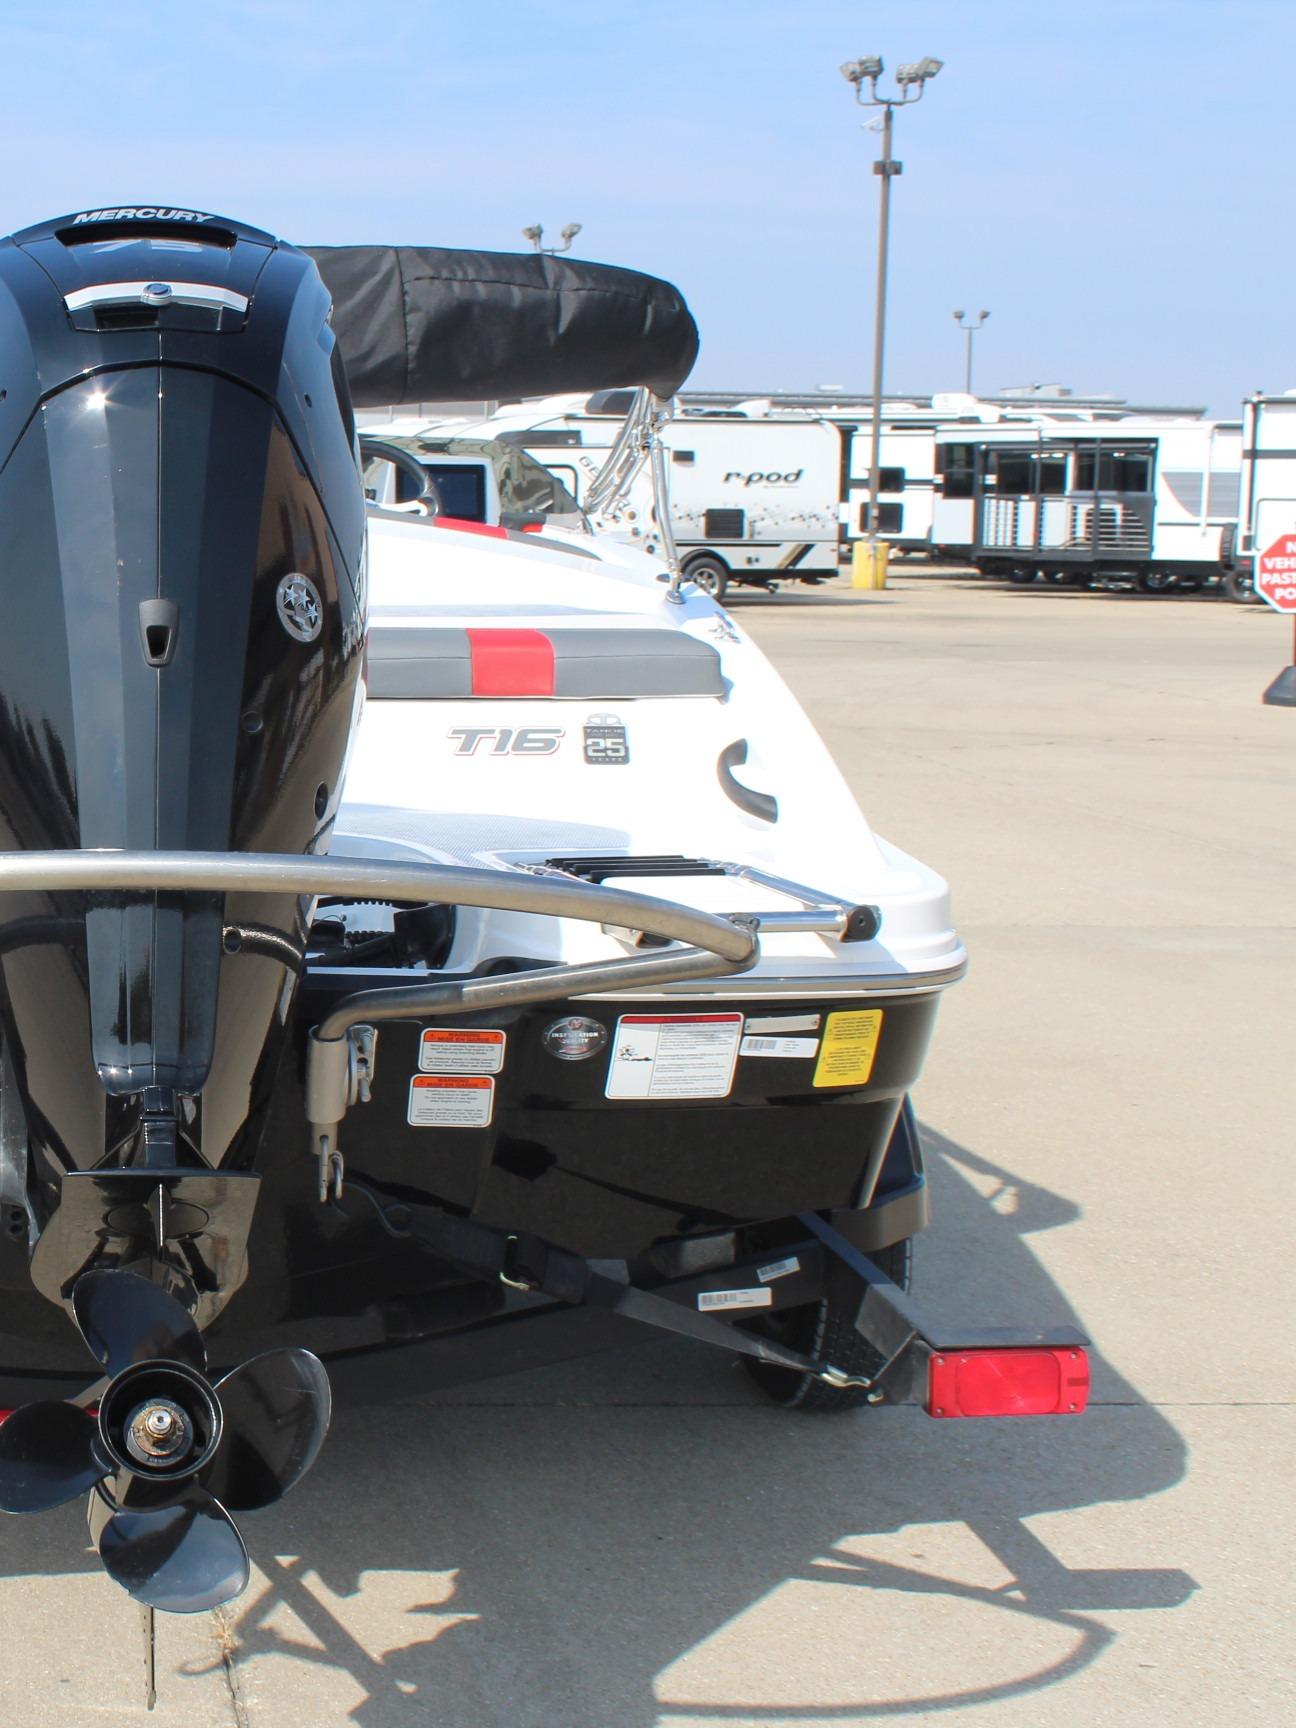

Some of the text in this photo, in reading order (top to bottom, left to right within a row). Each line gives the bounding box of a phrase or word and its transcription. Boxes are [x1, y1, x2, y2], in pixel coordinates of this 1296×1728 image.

[72, 208, 215, 225] MERCURY
[448, 727, 564, 755] T16
[586, 738, 625, 757] 25
